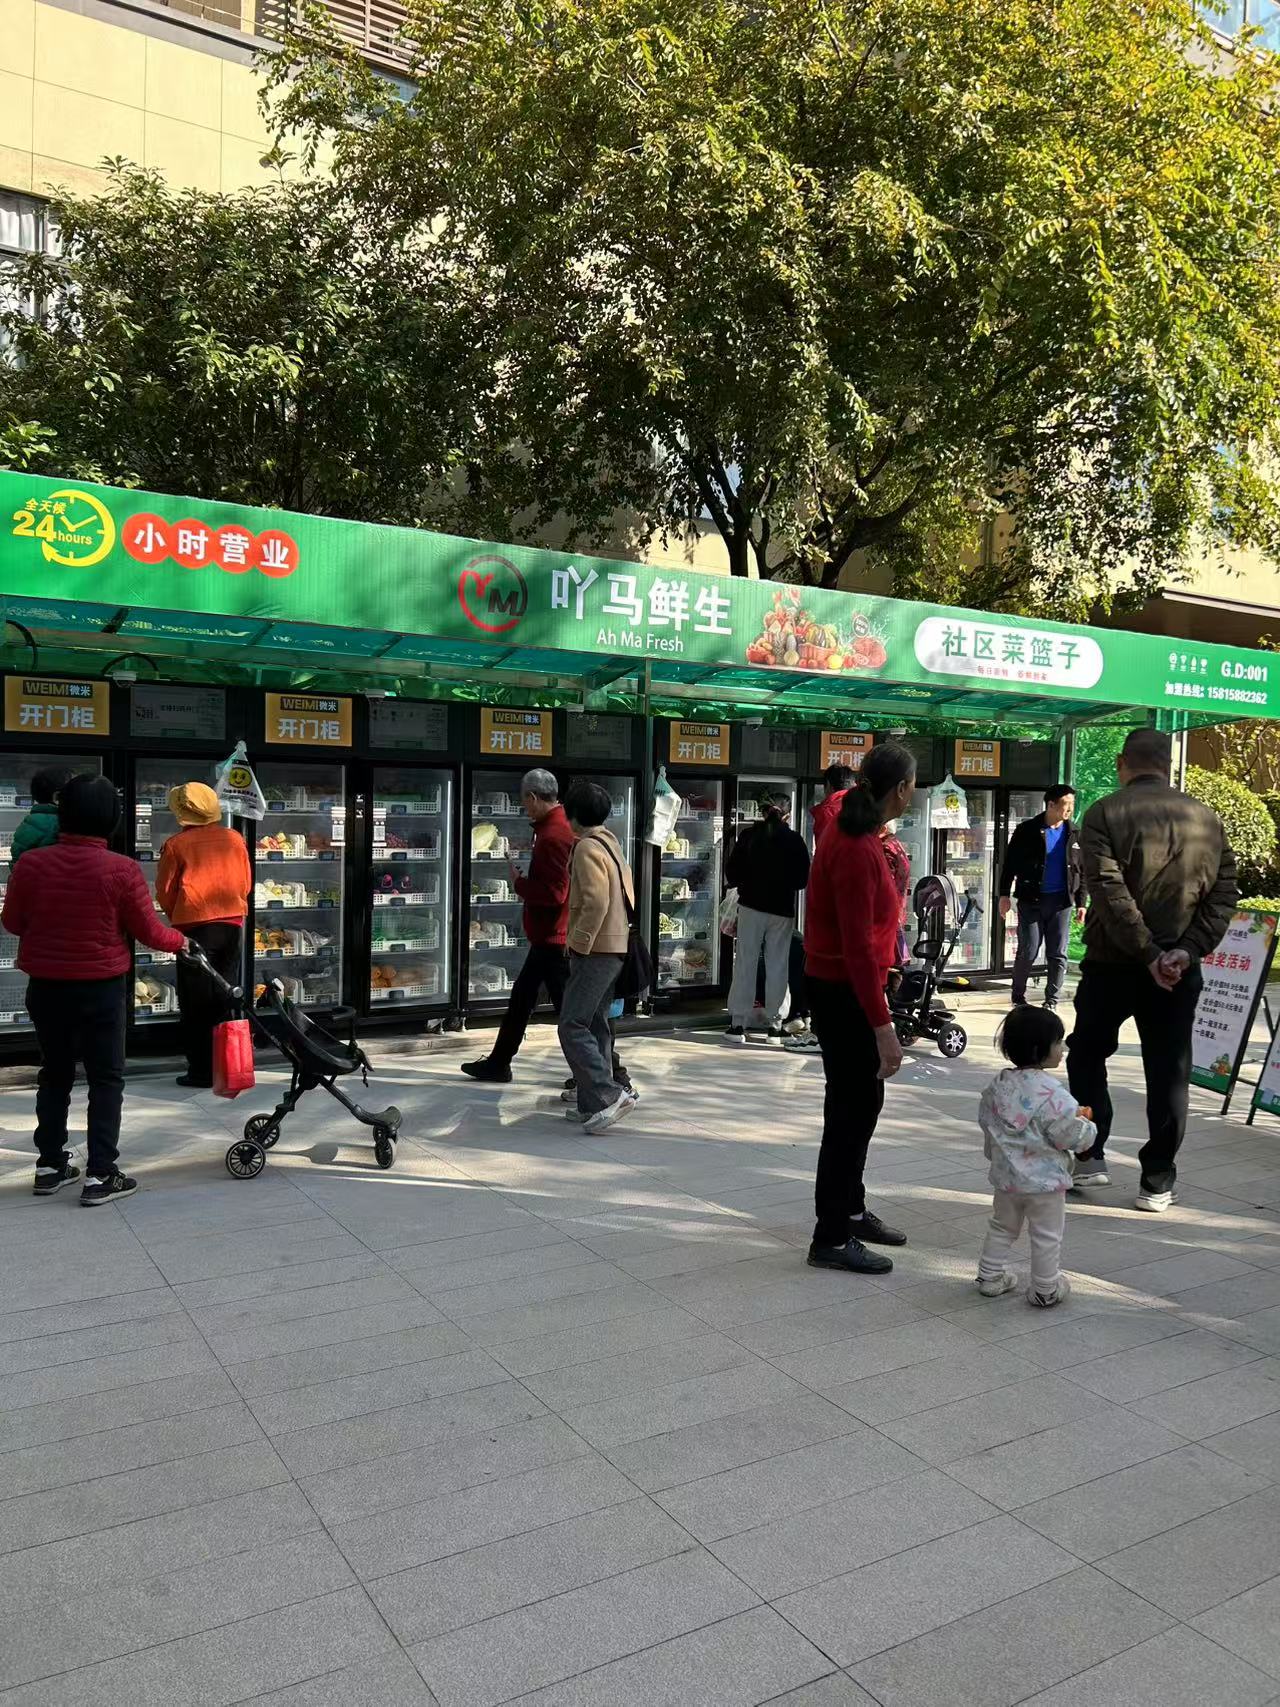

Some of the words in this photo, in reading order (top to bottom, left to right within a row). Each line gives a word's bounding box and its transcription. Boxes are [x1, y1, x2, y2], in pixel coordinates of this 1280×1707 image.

[25, 497, 66, 515] 全天候
[12, 510, 57, 542] 24
[57, 531, 93, 546] hours
[134, 522, 290, 569] 小时营业
[551, 565, 732, 635] 吖马鲜生
[597, 628, 617, 646] Ah
[621, 631, 642, 649] Ma
[647, 633, 684, 652] Fresh
[941, 625, 1080, 670] 社区菜篮子
[1220, 660, 1268, 682] G.D:001
[19, 703, 96, 728] 开门柜
[278, 718, 341, 740] 开门柜
[490, 730, 542, 750] 开门柜
[678, 742, 721, 760] 开门柜
[961, 757, 993, 772] 开门柜
